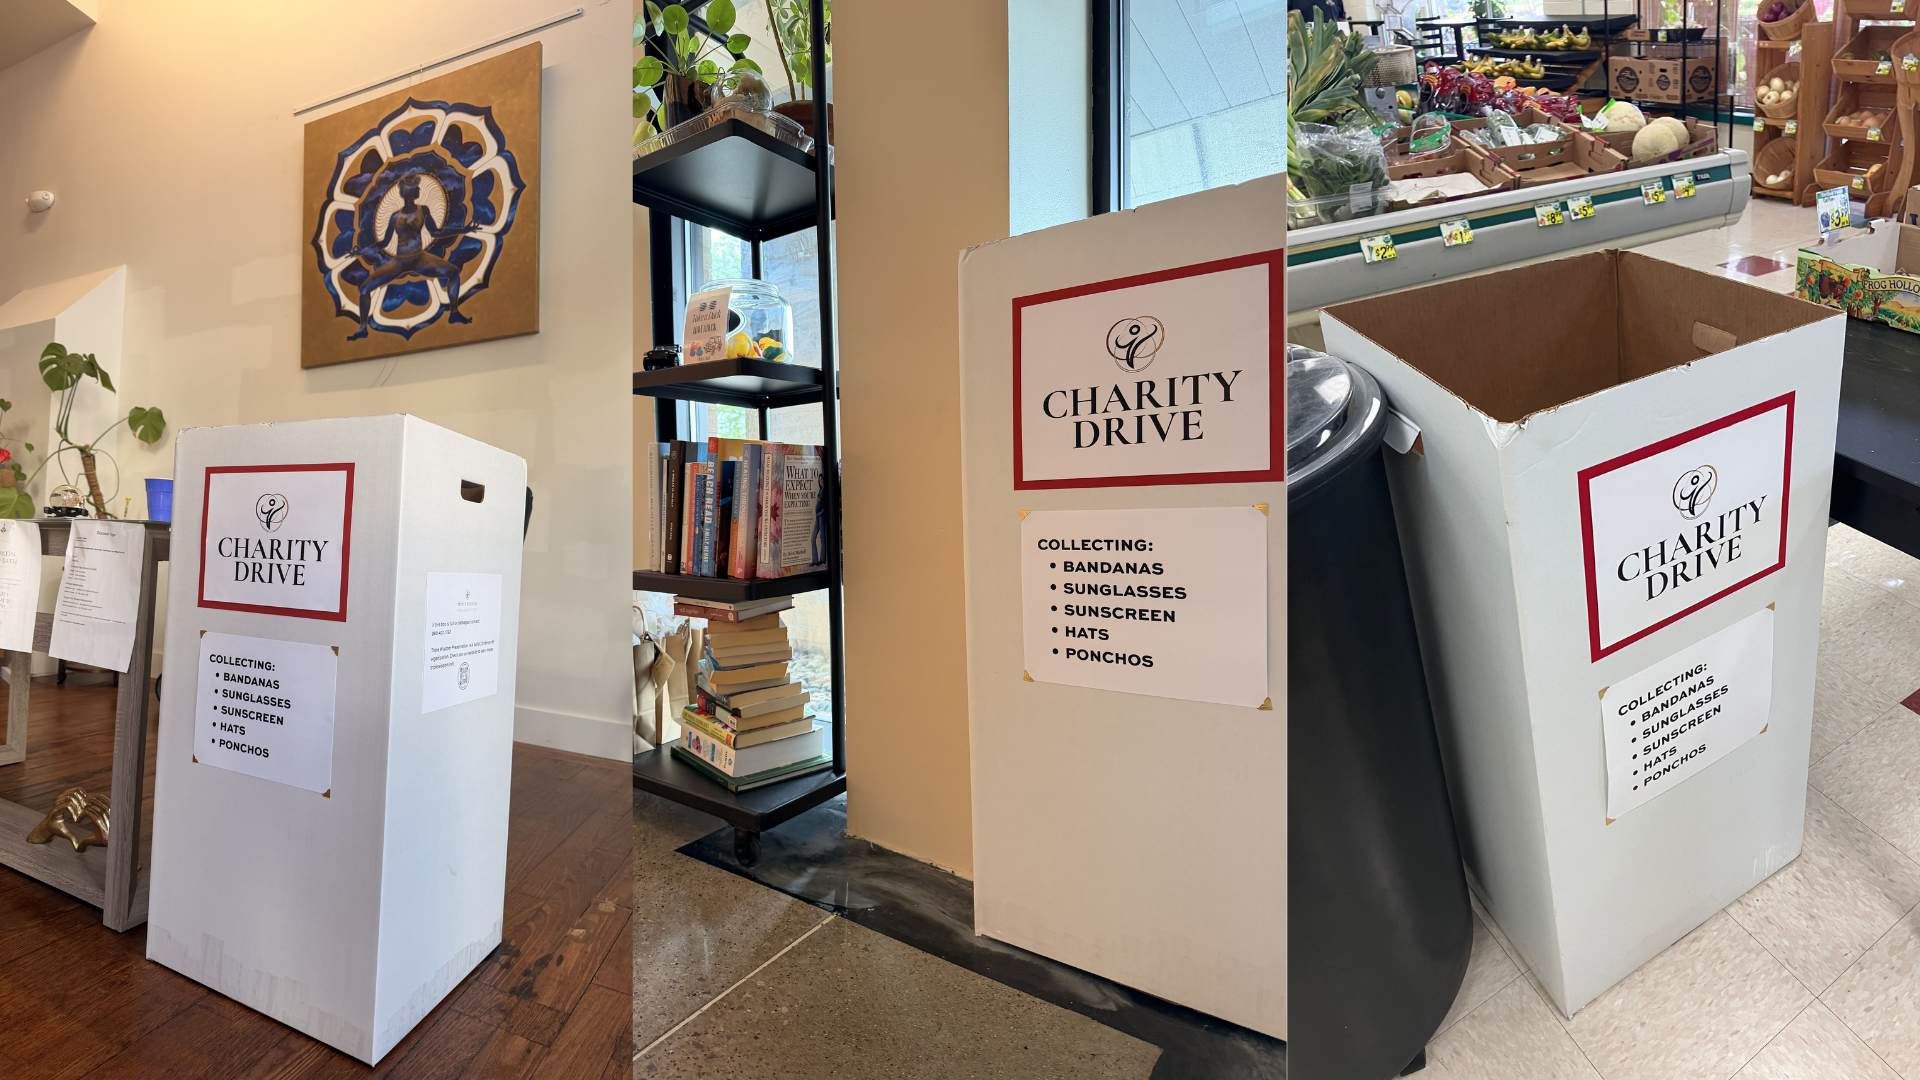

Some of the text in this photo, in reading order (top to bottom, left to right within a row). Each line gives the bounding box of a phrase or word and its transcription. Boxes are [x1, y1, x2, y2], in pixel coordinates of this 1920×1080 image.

[1863, 280, 1886, 290] FROG
[1042, 370, 1243, 419] CHARITY
[1073, 409, 1204, 449] DRIVE
[786, 466, 819, 479] WHAT TO
[705, 461, 714, 524] BEACH READ
[785, 480, 814, 491] EXPECT
[785, 492, 801, 500] WHEN
[1037, 539, 1154, 552] COLLECTING:
[1617, 494, 1768, 582] CHARITY
[218, 537, 329, 562] CHARITY
[234, 561, 305, 586] DRIVE
[1063, 561, 1164, 575] BANDANAS
[1646, 535, 1742, 601] DRIVE
[1063, 582, 1187, 600] SUNGLASSES
[1064, 604, 1175, 623] SUNSCREEN
[1065, 626, 1110, 641] HATS
[209, 654, 276, 671] COLLECTING:
[1066, 648, 1154, 668] PONCHOS
[224, 672, 280, 689] BANDANAS
[1618, 663, 1707, 716] COLLECTING:
[222, 688, 291, 709] SUNGLASSES
[1641, 675, 1714, 722] BANDANAS
[221, 705, 284, 725] SUNSCREEN
[1642, 685, 1729, 739] SUNGLASSES
[220, 722, 246, 735] HATS
[1643, 704, 1722, 756] SUNSCREEN
[219, 739, 270, 758] PONCHOS
[1643, 746, 1677, 772] HATS
[1643, 744, 1707, 787] PONCHOS
